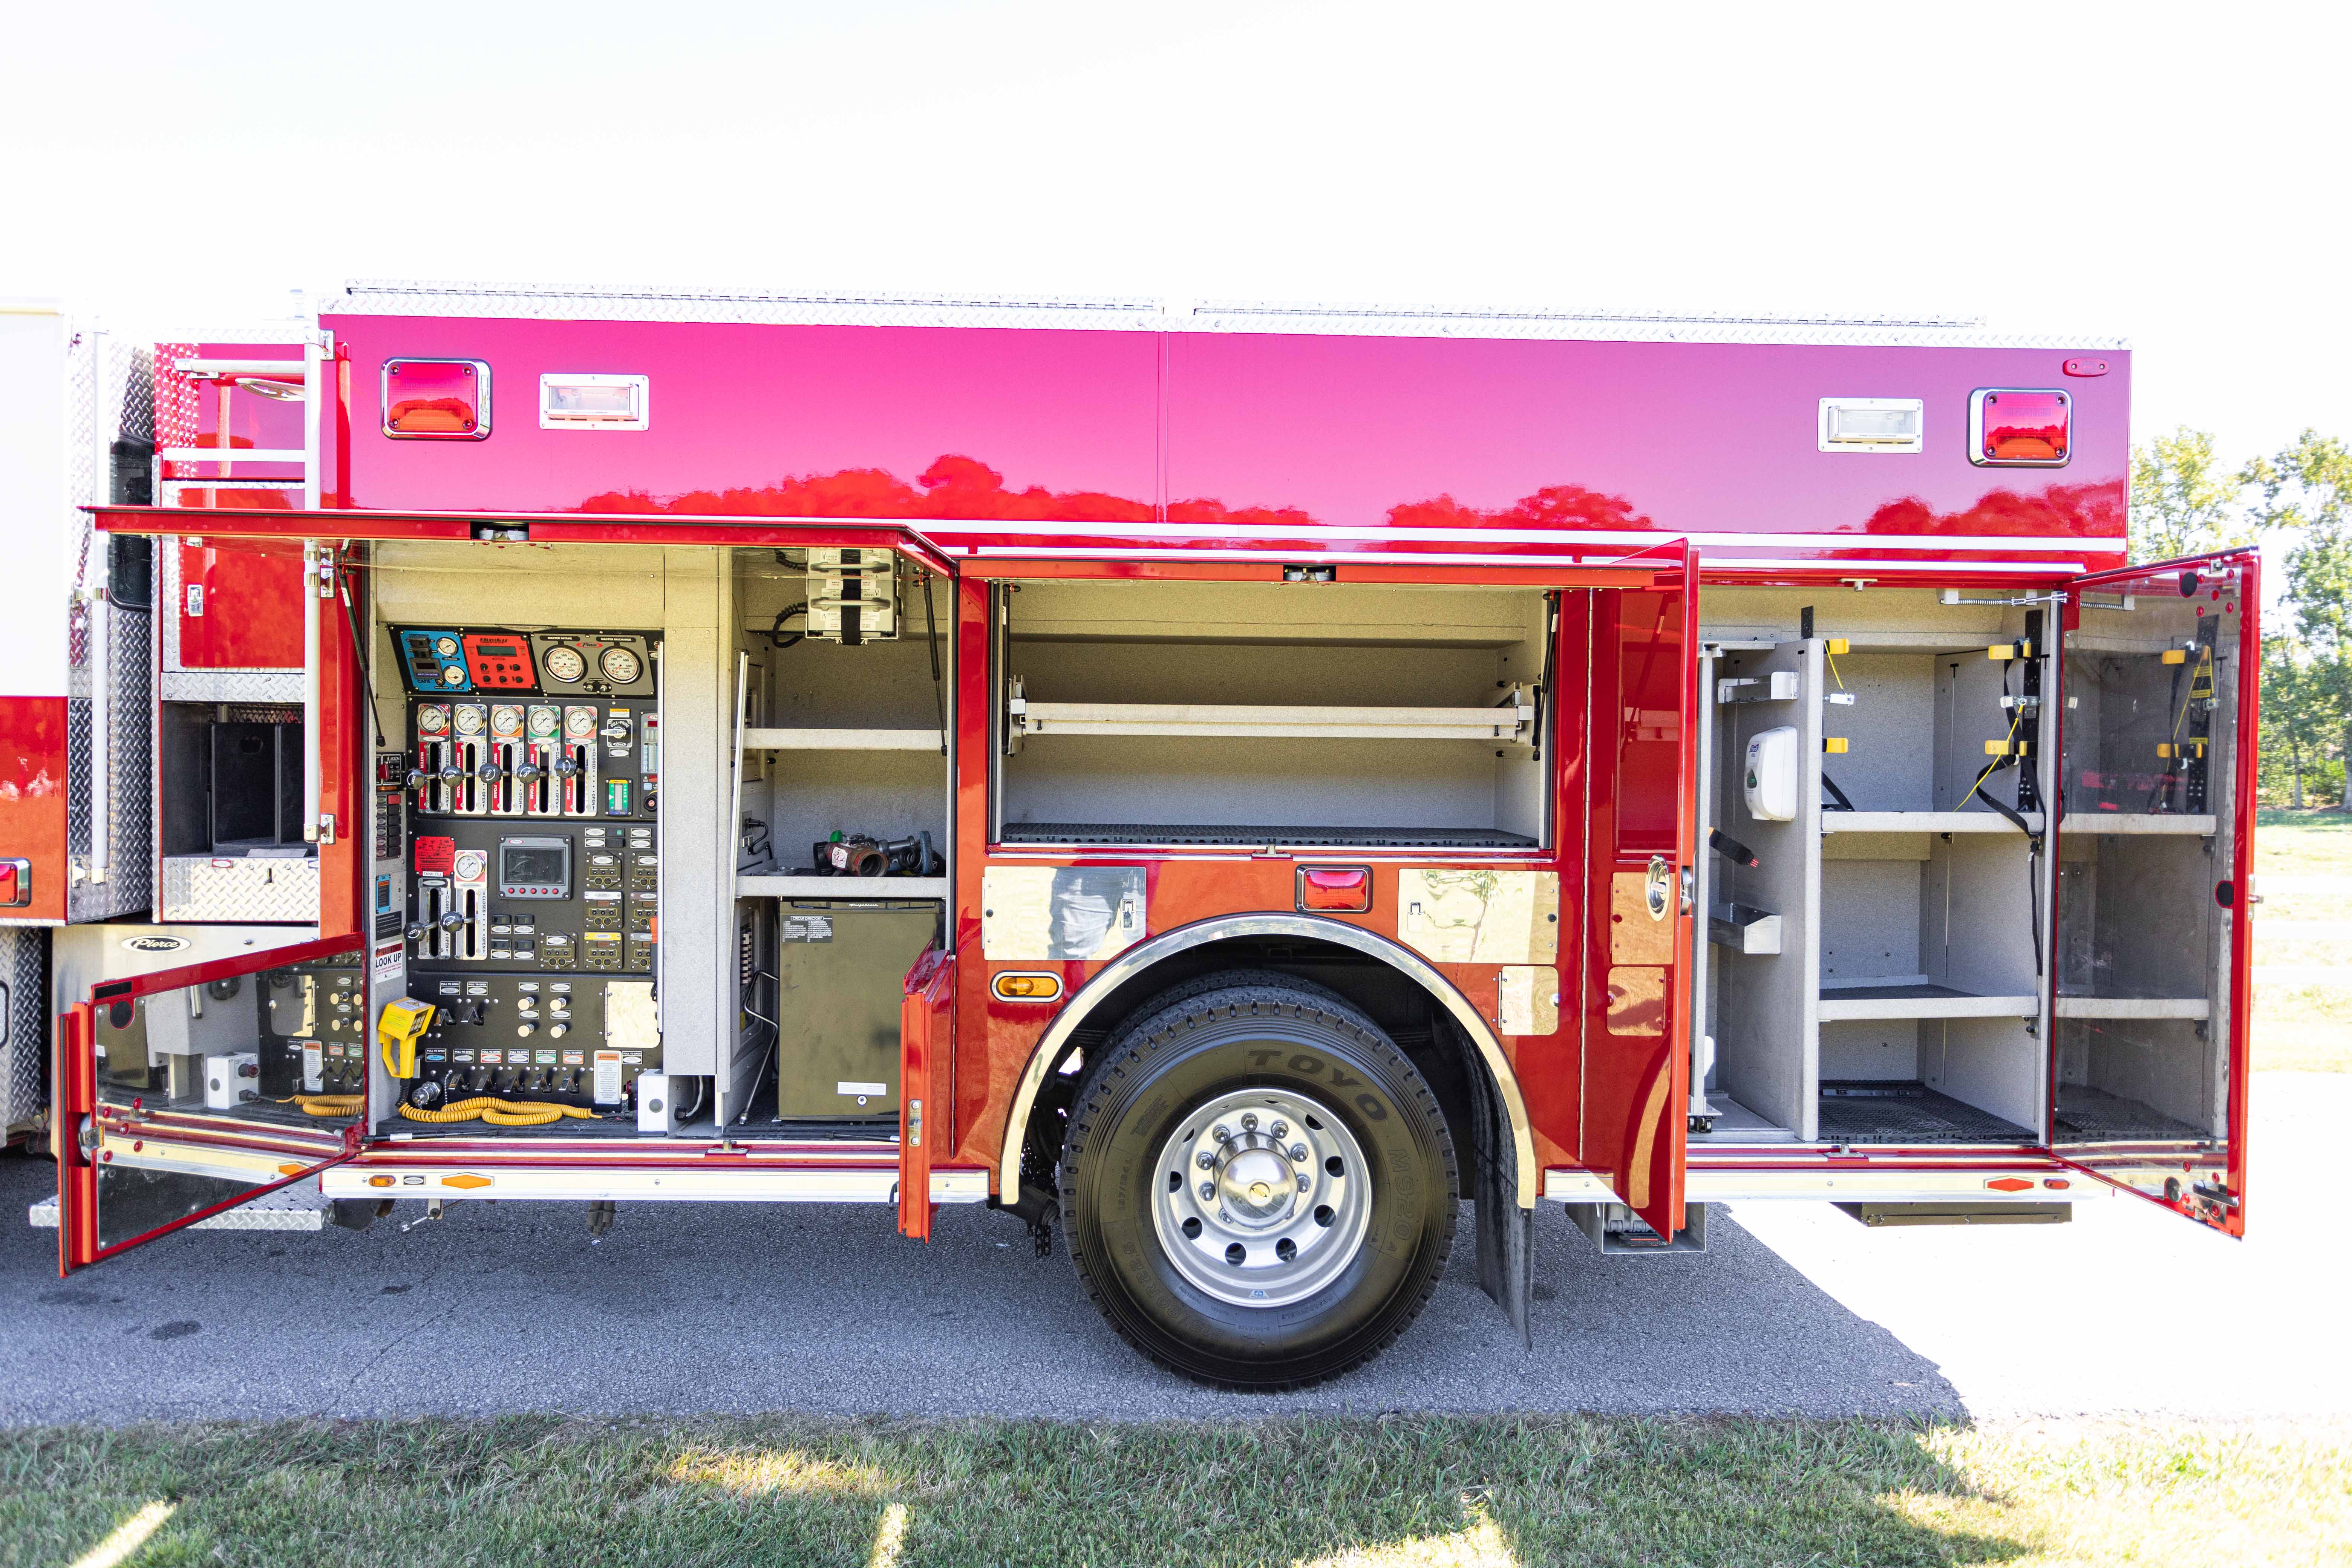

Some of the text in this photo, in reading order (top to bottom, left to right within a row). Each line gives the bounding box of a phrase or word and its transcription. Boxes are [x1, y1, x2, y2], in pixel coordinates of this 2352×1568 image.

[133, 939, 178, 948] Pierce
[375, 952, 401, 968] LOOK UP
[1247, 1049, 1388, 1122] TOYO
[1387, 1149, 1415, 1240] M920
[1124, 1242, 1225, 1340] 315/80R22.5
[1281, 1294, 1333, 1320] REGROOVABLE
